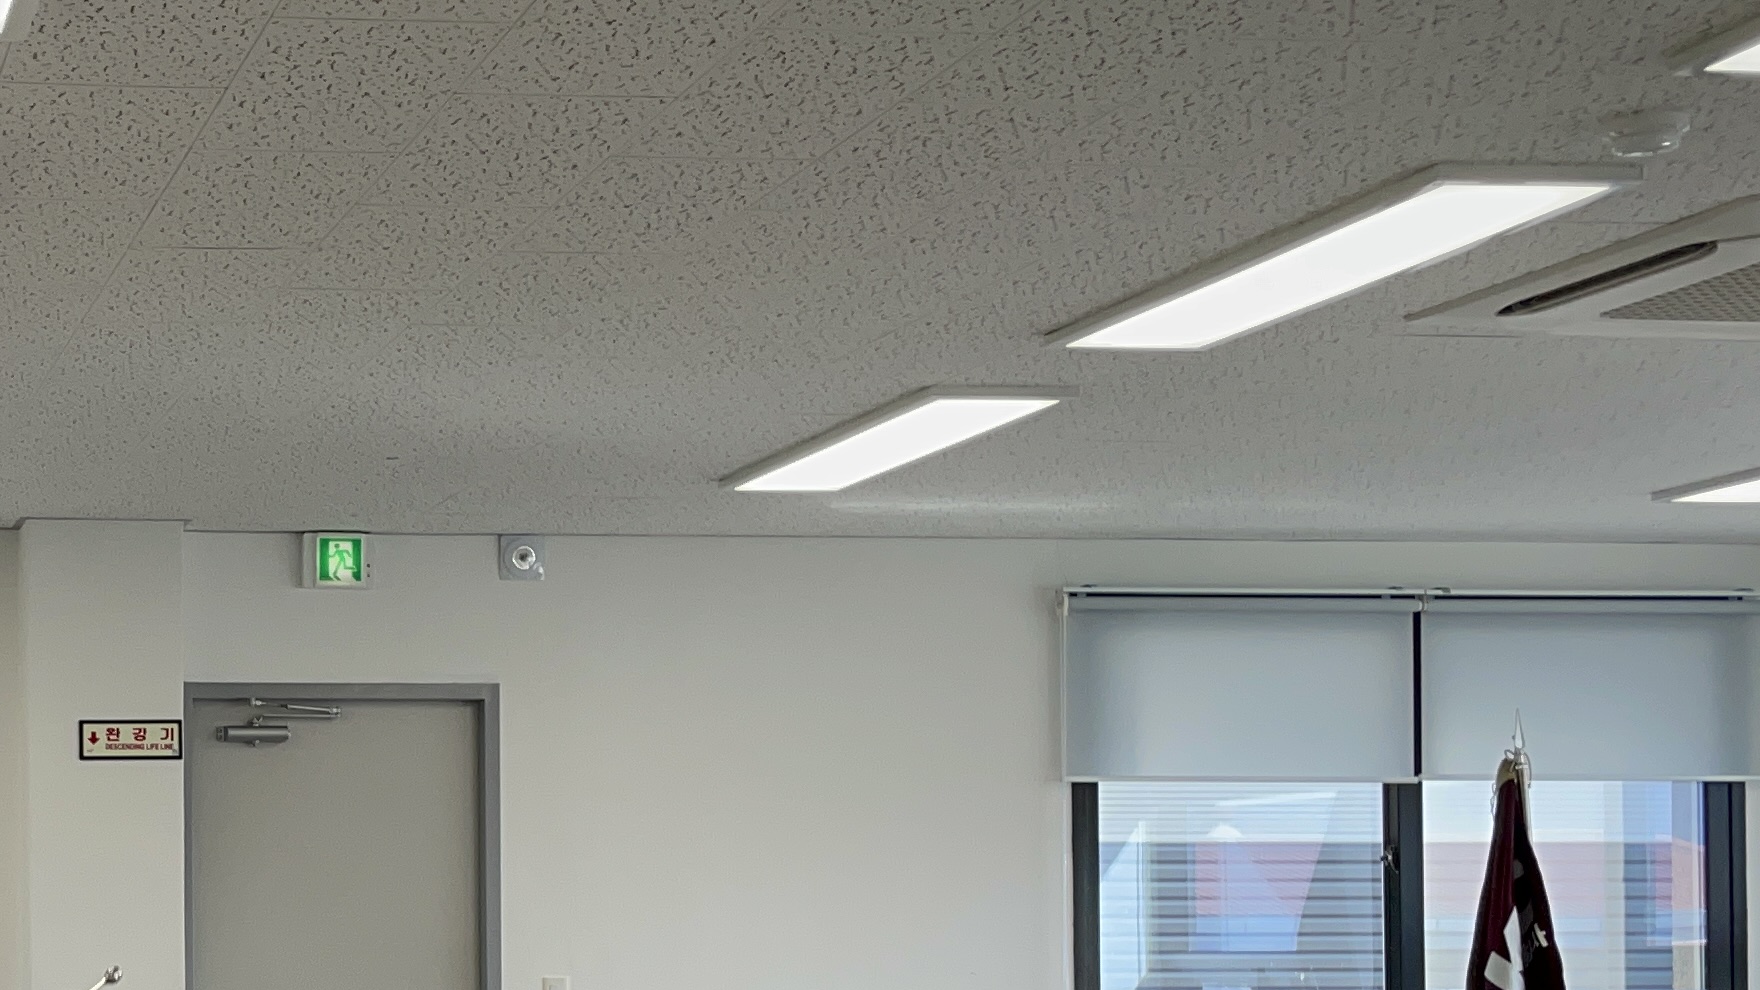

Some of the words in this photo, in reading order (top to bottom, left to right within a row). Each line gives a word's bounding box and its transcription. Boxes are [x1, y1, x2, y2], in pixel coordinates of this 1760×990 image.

[105, 743, 145, 751] DESCENDING
[146, 743, 159, 751] LIFE
[160, 743, 174, 751] LINE
